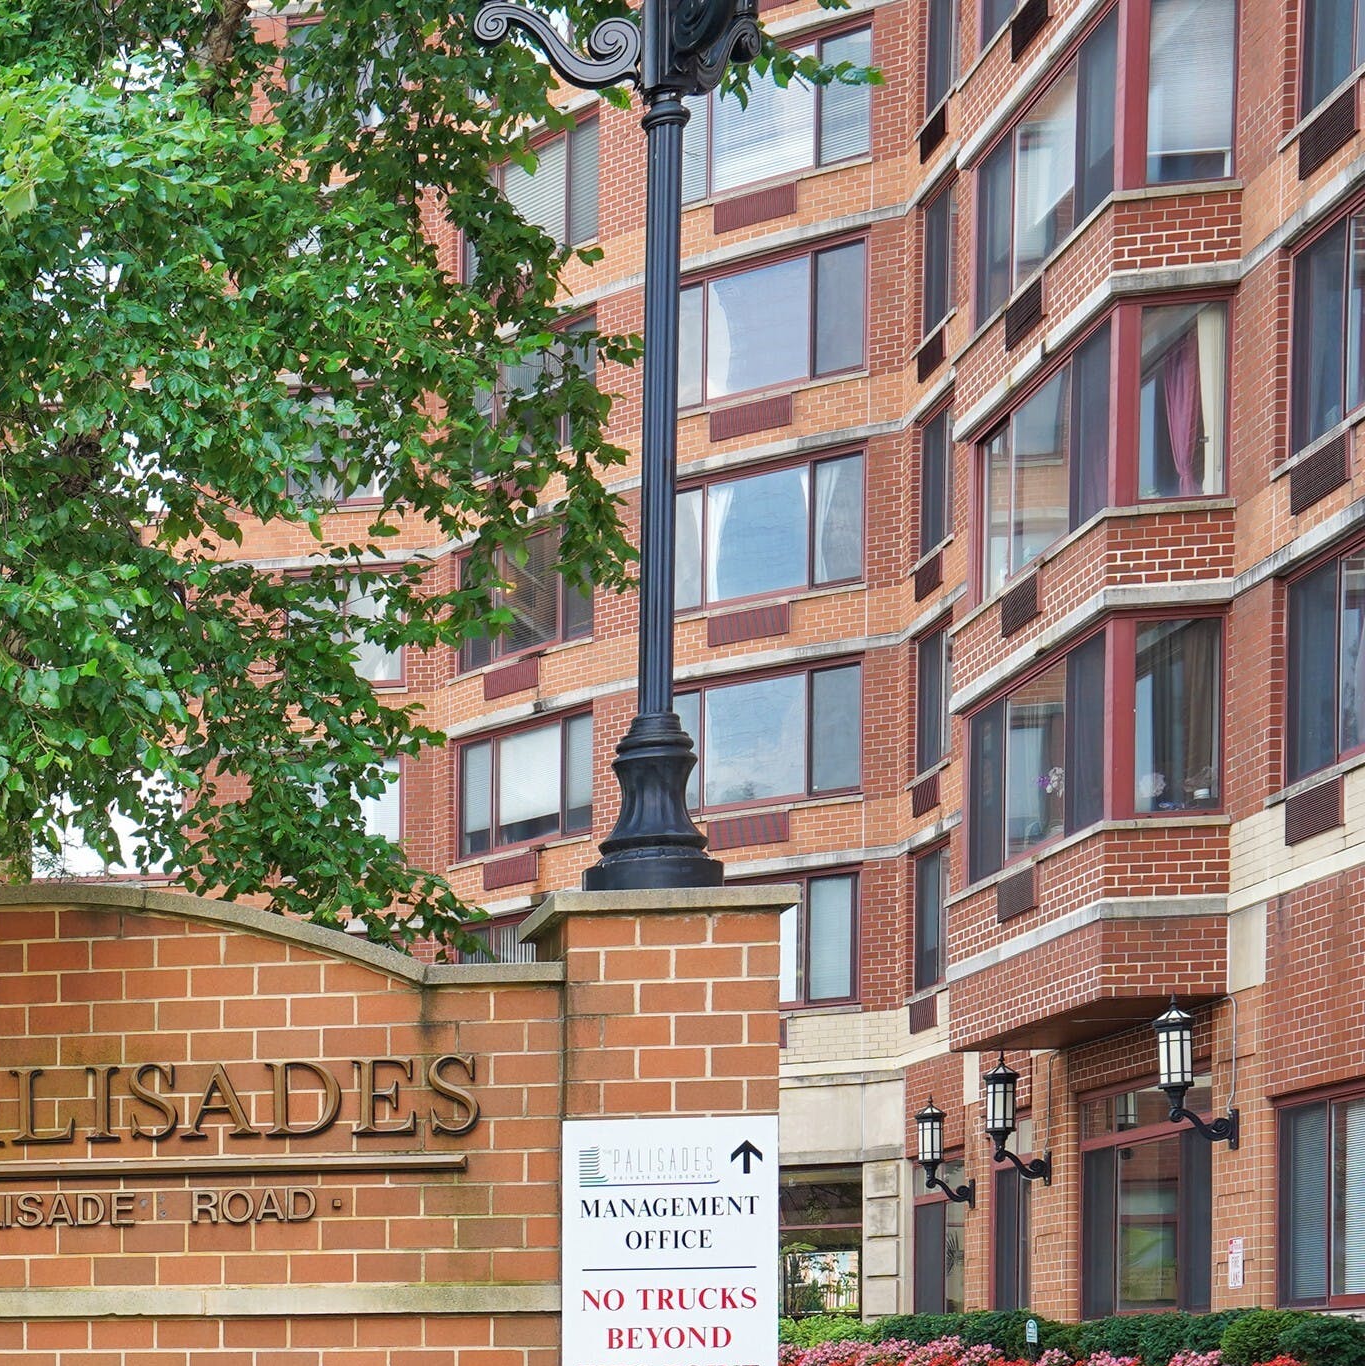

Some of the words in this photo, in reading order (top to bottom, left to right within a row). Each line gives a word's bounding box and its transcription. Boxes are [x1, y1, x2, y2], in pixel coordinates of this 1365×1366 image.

[613, 1146, 713, 1172] PALISADES
[191, 1186, 318, 1224] ROAD
[579, 1196, 760, 1219] MANAGEMENT
[625, 1229, 713, 1250] OFFICE
[582, 1288, 625, 1312] NO
[636, 1286, 758, 1311] TRUCKS
[606, 1326, 732, 1350] BEYOND
